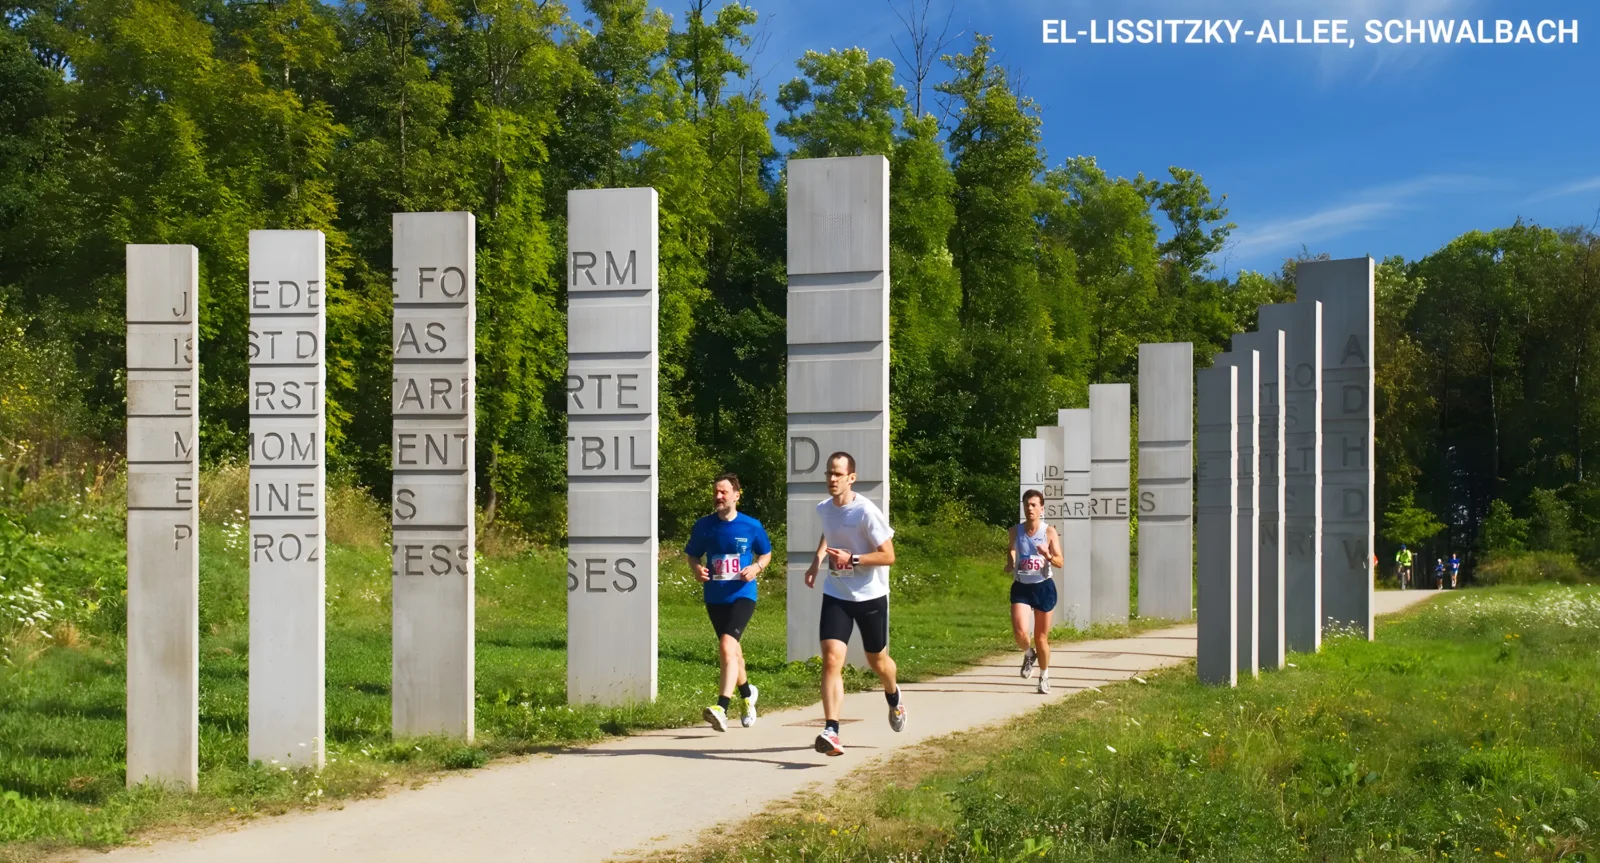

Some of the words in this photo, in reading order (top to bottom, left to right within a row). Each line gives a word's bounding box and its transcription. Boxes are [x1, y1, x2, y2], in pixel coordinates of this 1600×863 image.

[572, 250, 636, 286] RM
[172, 291, 187, 317] J
[394, 322, 447, 354] AS
[567, 436, 651, 470] BIL
[790, 436, 820, 475] D
[255, 483, 316, 512] INE
[394, 488, 417, 520] S
[1140, 491, 1156, 512] S
[715, 558, 740, 575] 219
